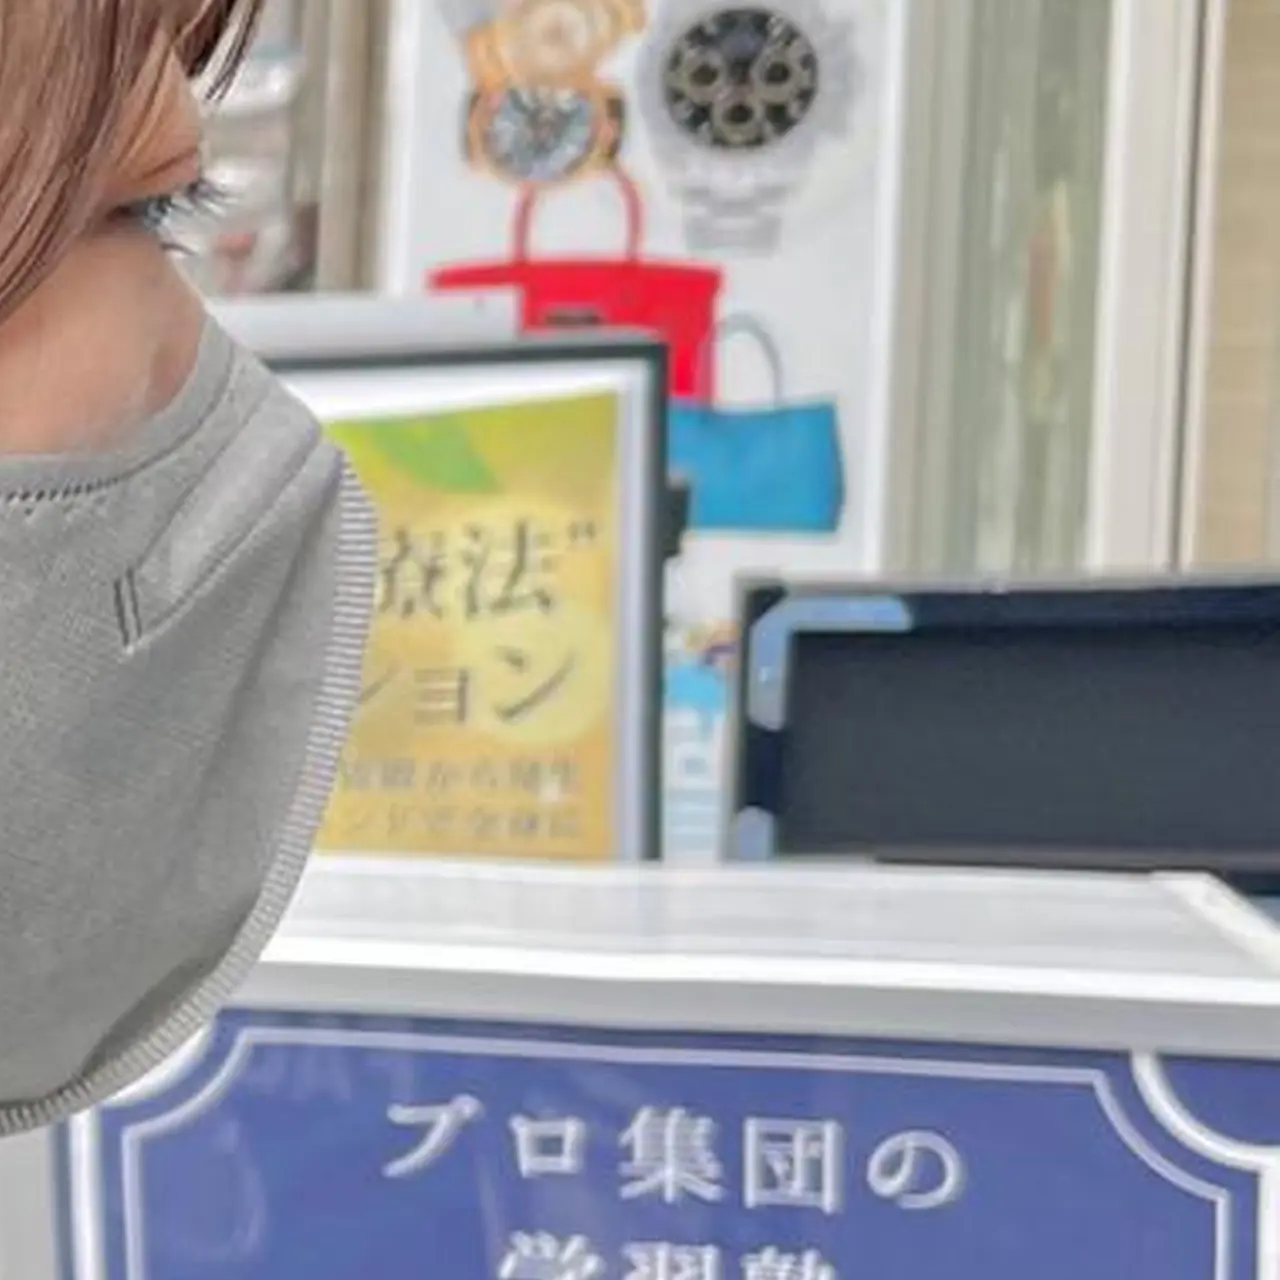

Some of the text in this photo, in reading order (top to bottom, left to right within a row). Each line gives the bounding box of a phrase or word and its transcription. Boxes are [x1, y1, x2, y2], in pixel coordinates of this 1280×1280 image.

[384, 1093, 968, 1215] プロ集団の
